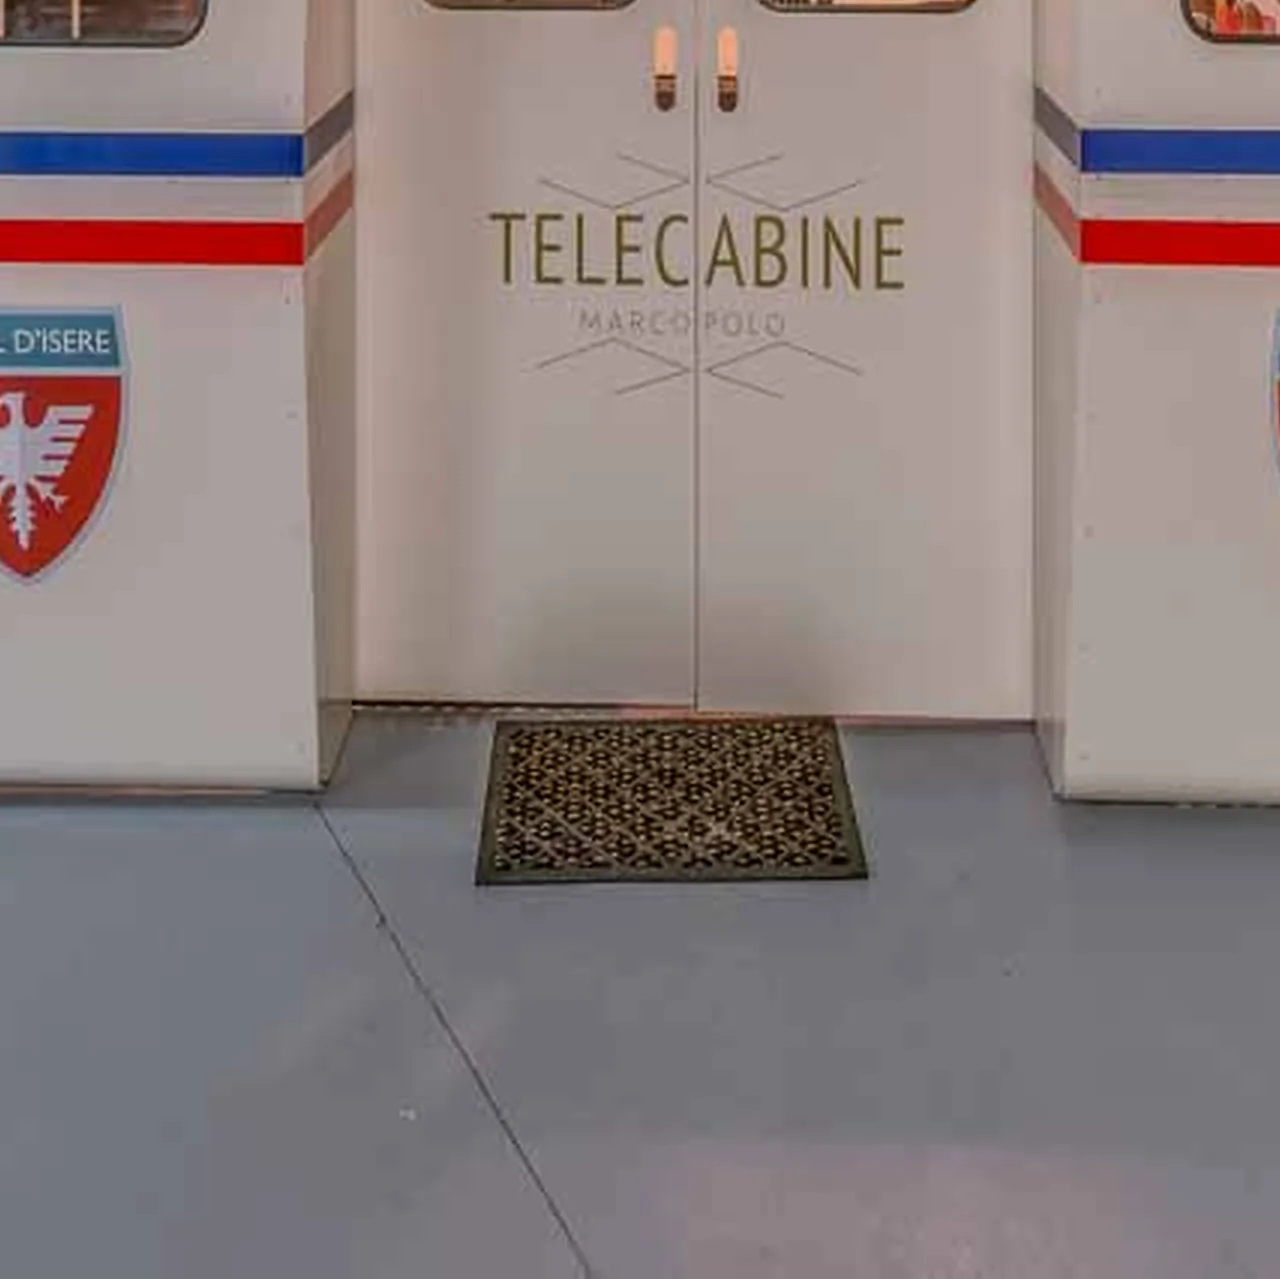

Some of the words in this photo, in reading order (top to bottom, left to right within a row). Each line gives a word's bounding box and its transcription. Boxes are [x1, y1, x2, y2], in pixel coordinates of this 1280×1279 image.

[489, 213, 906, 291] TELECABINE
[579, 309, 691, 337] MARCO
[704, 310, 786, 338] POLO
[14, 328, 111, 355] D'ISERE
